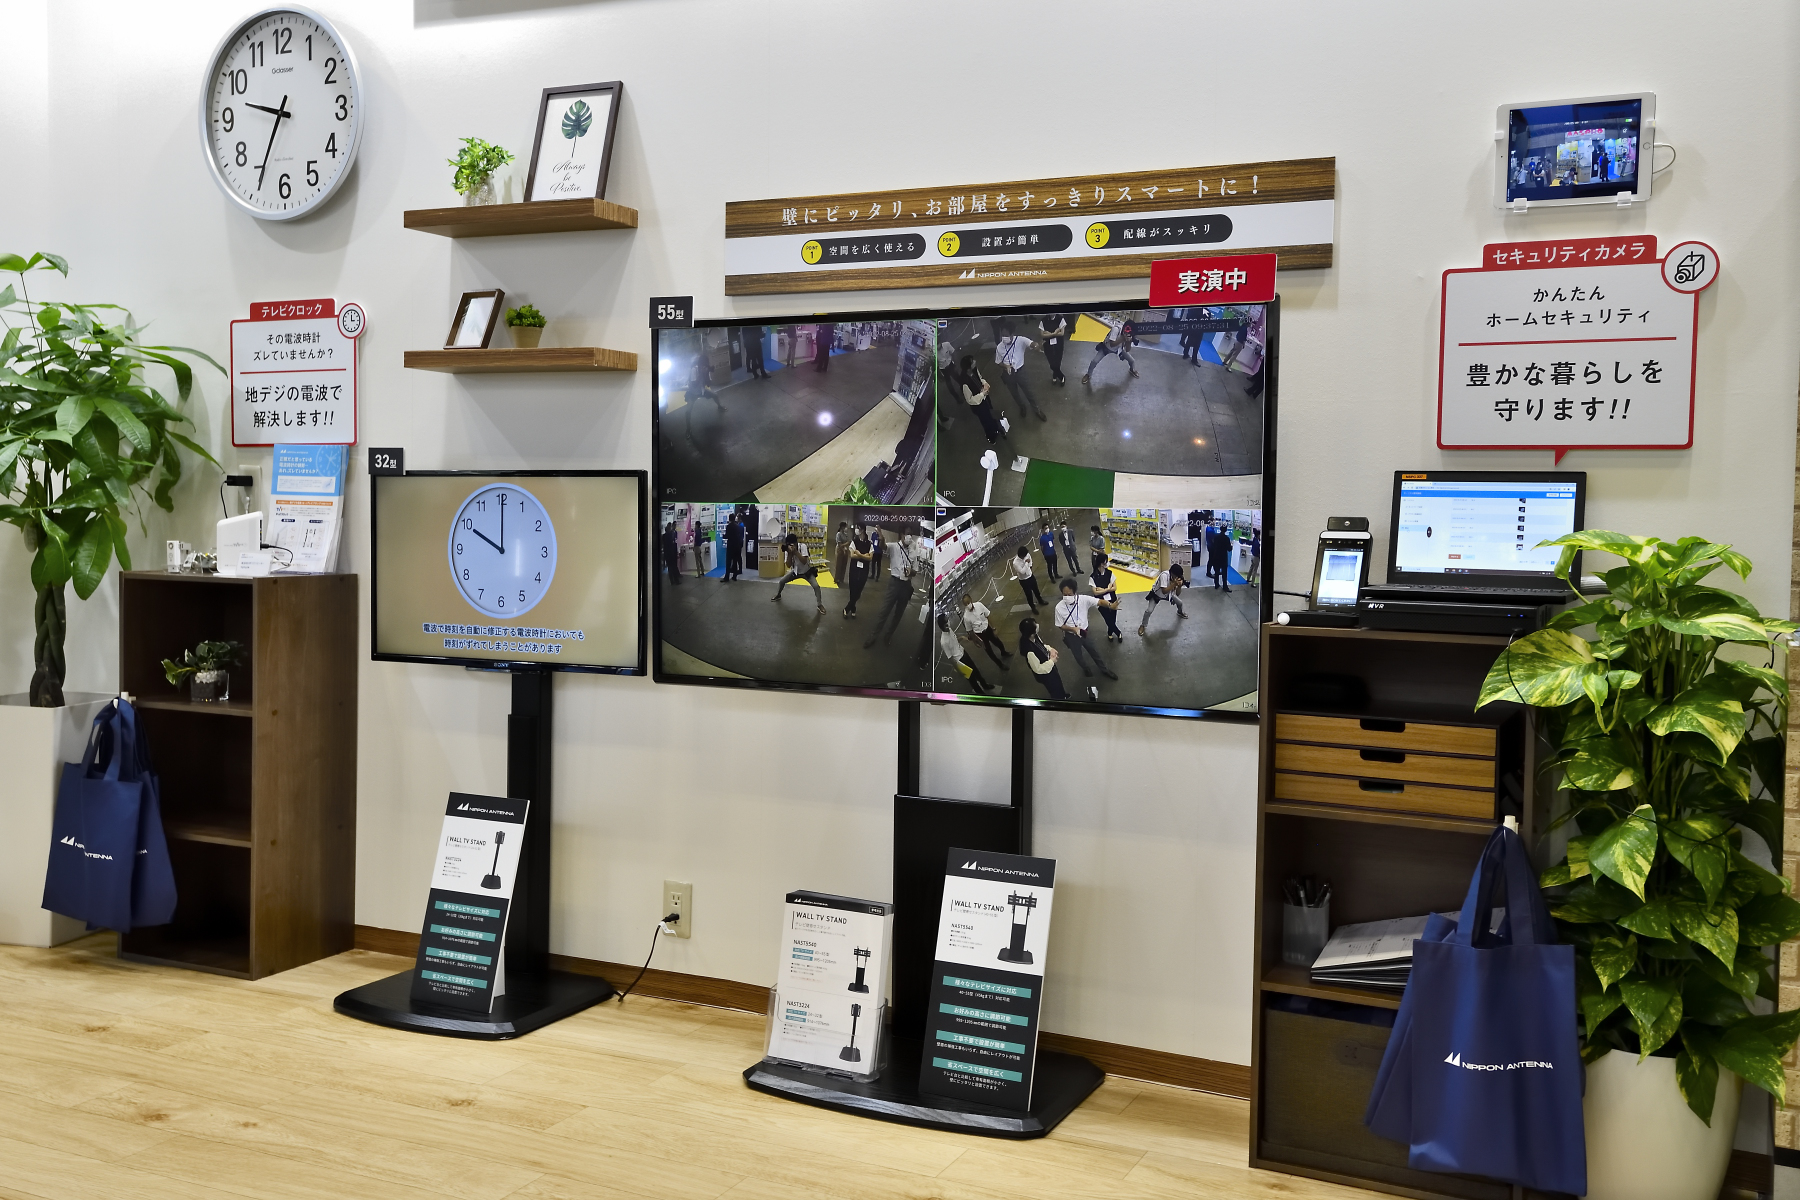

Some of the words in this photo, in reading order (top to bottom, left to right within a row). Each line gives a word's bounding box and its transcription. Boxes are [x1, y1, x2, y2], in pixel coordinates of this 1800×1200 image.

[272, 27, 293, 55] 12
[305, 34, 313, 61] 1
[249, 41, 264, 68] 11
[324, 57, 337, 85] 2
[228, 69, 248, 96] 10
[335, 94, 348, 121] 3
[222, 107, 235, 133] 9
[324, 132, 338, 159] 4
[235, 141, 247, 168] 8
[306, 160, 319, 187] 5
[278, 173, 292, 200] 6
[781, 175, 1259, 227] 壁にピッタリ、お部屋をすっきりスマートに！
[1095, 234, 1101, 243] 3
[1123, 223, 1211, 240] 配線がスッキリ
[946, 243, 952, 252] 2
[981, 233, 1039, 248] 設置が簡単
[810, 251, 815, 259] 1
[829, 242, 915, 256] 空間を広く使える
[1492, 242, 1646, 266] セキュリティカメラ
[977, 270, 1007, 278] NIPPON
[1008, 269, 1048, 277] ANTENNA
[1178, 268, 1247, 294] 実演中
[1533, 285, 1605, 303] かんたん
[261, 303, 322, 318] テレビクロック
[657, 304, 684, 321] 55型
[1486, 308, 1651, 328] ホームセキュリティ
[1137, 323, 1189, 332] 2022-08-25
[266, 332, 321, 345] その電波時計
[1466, 359, 1663, 388] 豊かな暮らしを
[245, 384, 343, 403] 地デジの電波で
[375, 454, 397, 469] 32型
[496, 493, 508, 506] 12
[943, 490, 956, 498] IPC
[476, 500, 486, 512] 11
[519, 501, 524, 513] 1
[461, 518, 473, 531] 10
[864, 514, 899, 522] 2022-08-25
[535, 519, 542, 532] 2
[456, 543, 463, 555] 9
[541, 546, 548, 559] 3
[463, 569, 470, 581] 8
[534, 572, 542, 584] 4
[478, 588, 485, 600] 7
[518, 590, 526, 603] 5
[497, 595, 505, 608] 6
[422, 623, 585, 641] 電波で時刻を自動に修正する電波時計においても
[443, 638, 562, 655] 時刻がずれてしまうことがあります
[941, 676, 953, 684] IPC
[449, 836, 462, 844] WALL
[84, 852, 113, 860] NTENNA
[977, 866, 1004, 874] NIPPON
[1004, 870, 1040, 878] ANTENNA
[954, 900, 972, 909] WALL
[983, 904, 1005, 913] STAND
[796, 911, 814, 920] WALL
[825, 915, 848, 925] STAND
[1462, 1061, 1504, 1072] NIPPON
[1506, 1060, 1553, 1071] ANTENNA
